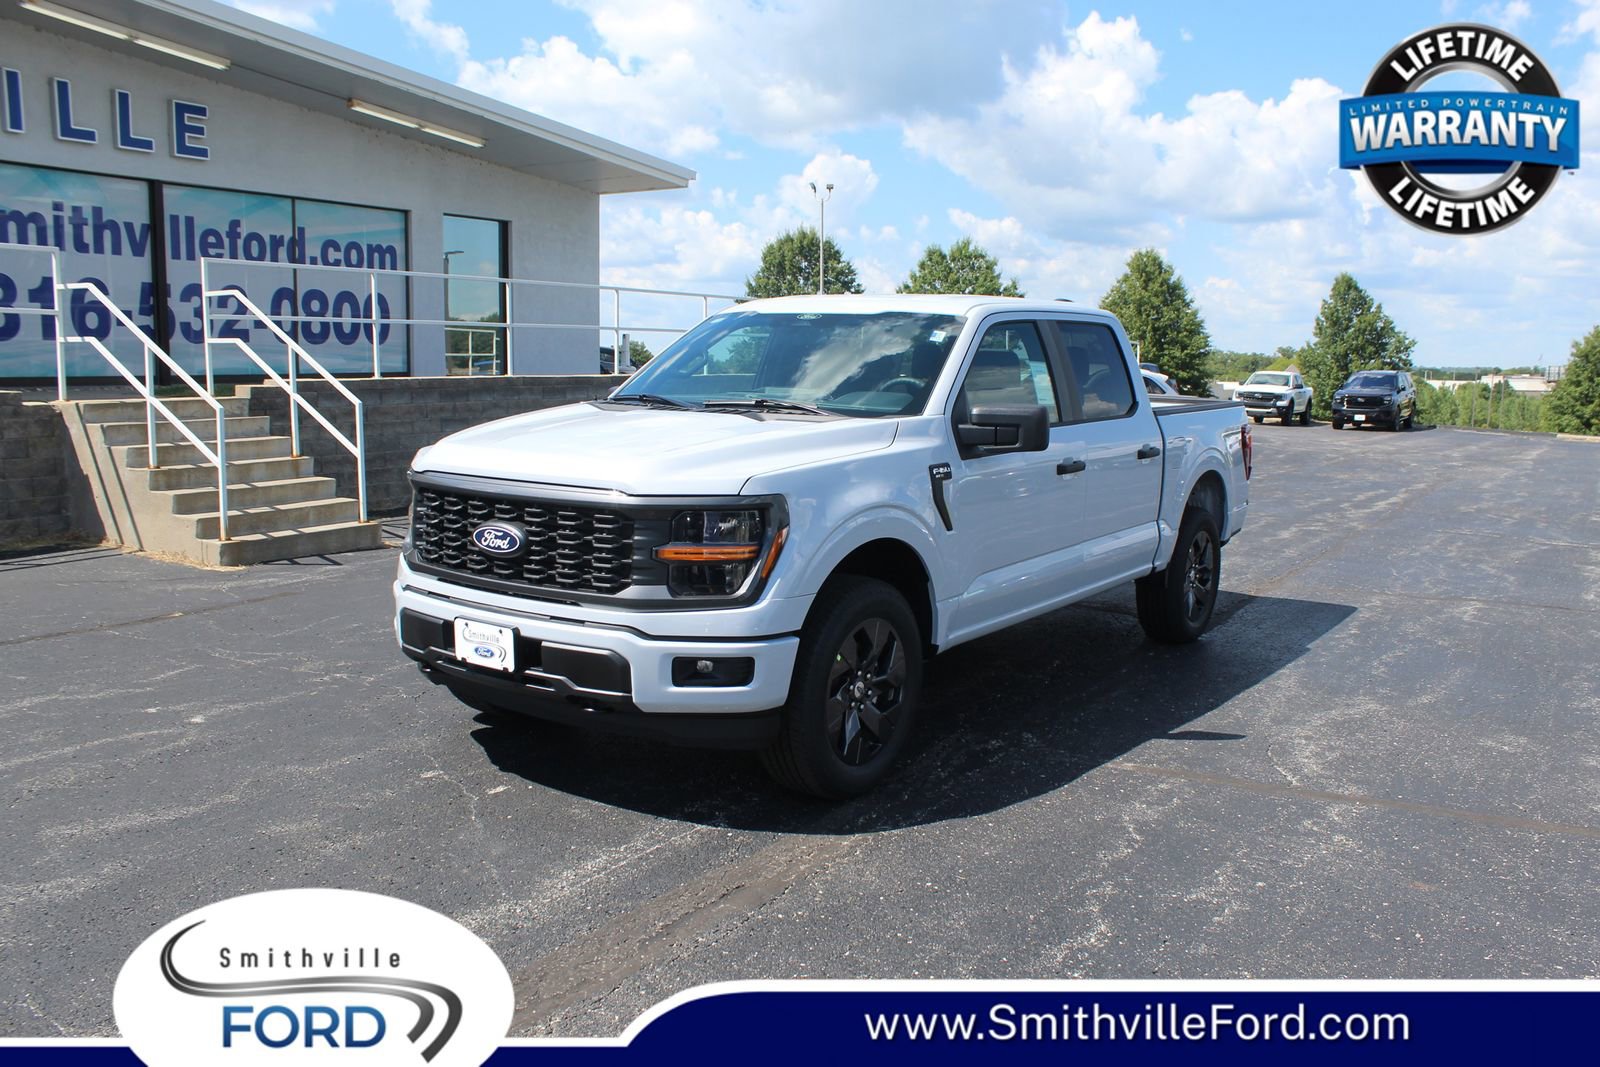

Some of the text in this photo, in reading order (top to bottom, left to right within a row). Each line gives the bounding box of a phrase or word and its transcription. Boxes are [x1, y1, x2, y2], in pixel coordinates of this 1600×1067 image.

[2, 67, 210, 160] ILLE
[0, 200, 398, 270] mithvlleford.com
[480, 529, 511, 550] Ford
